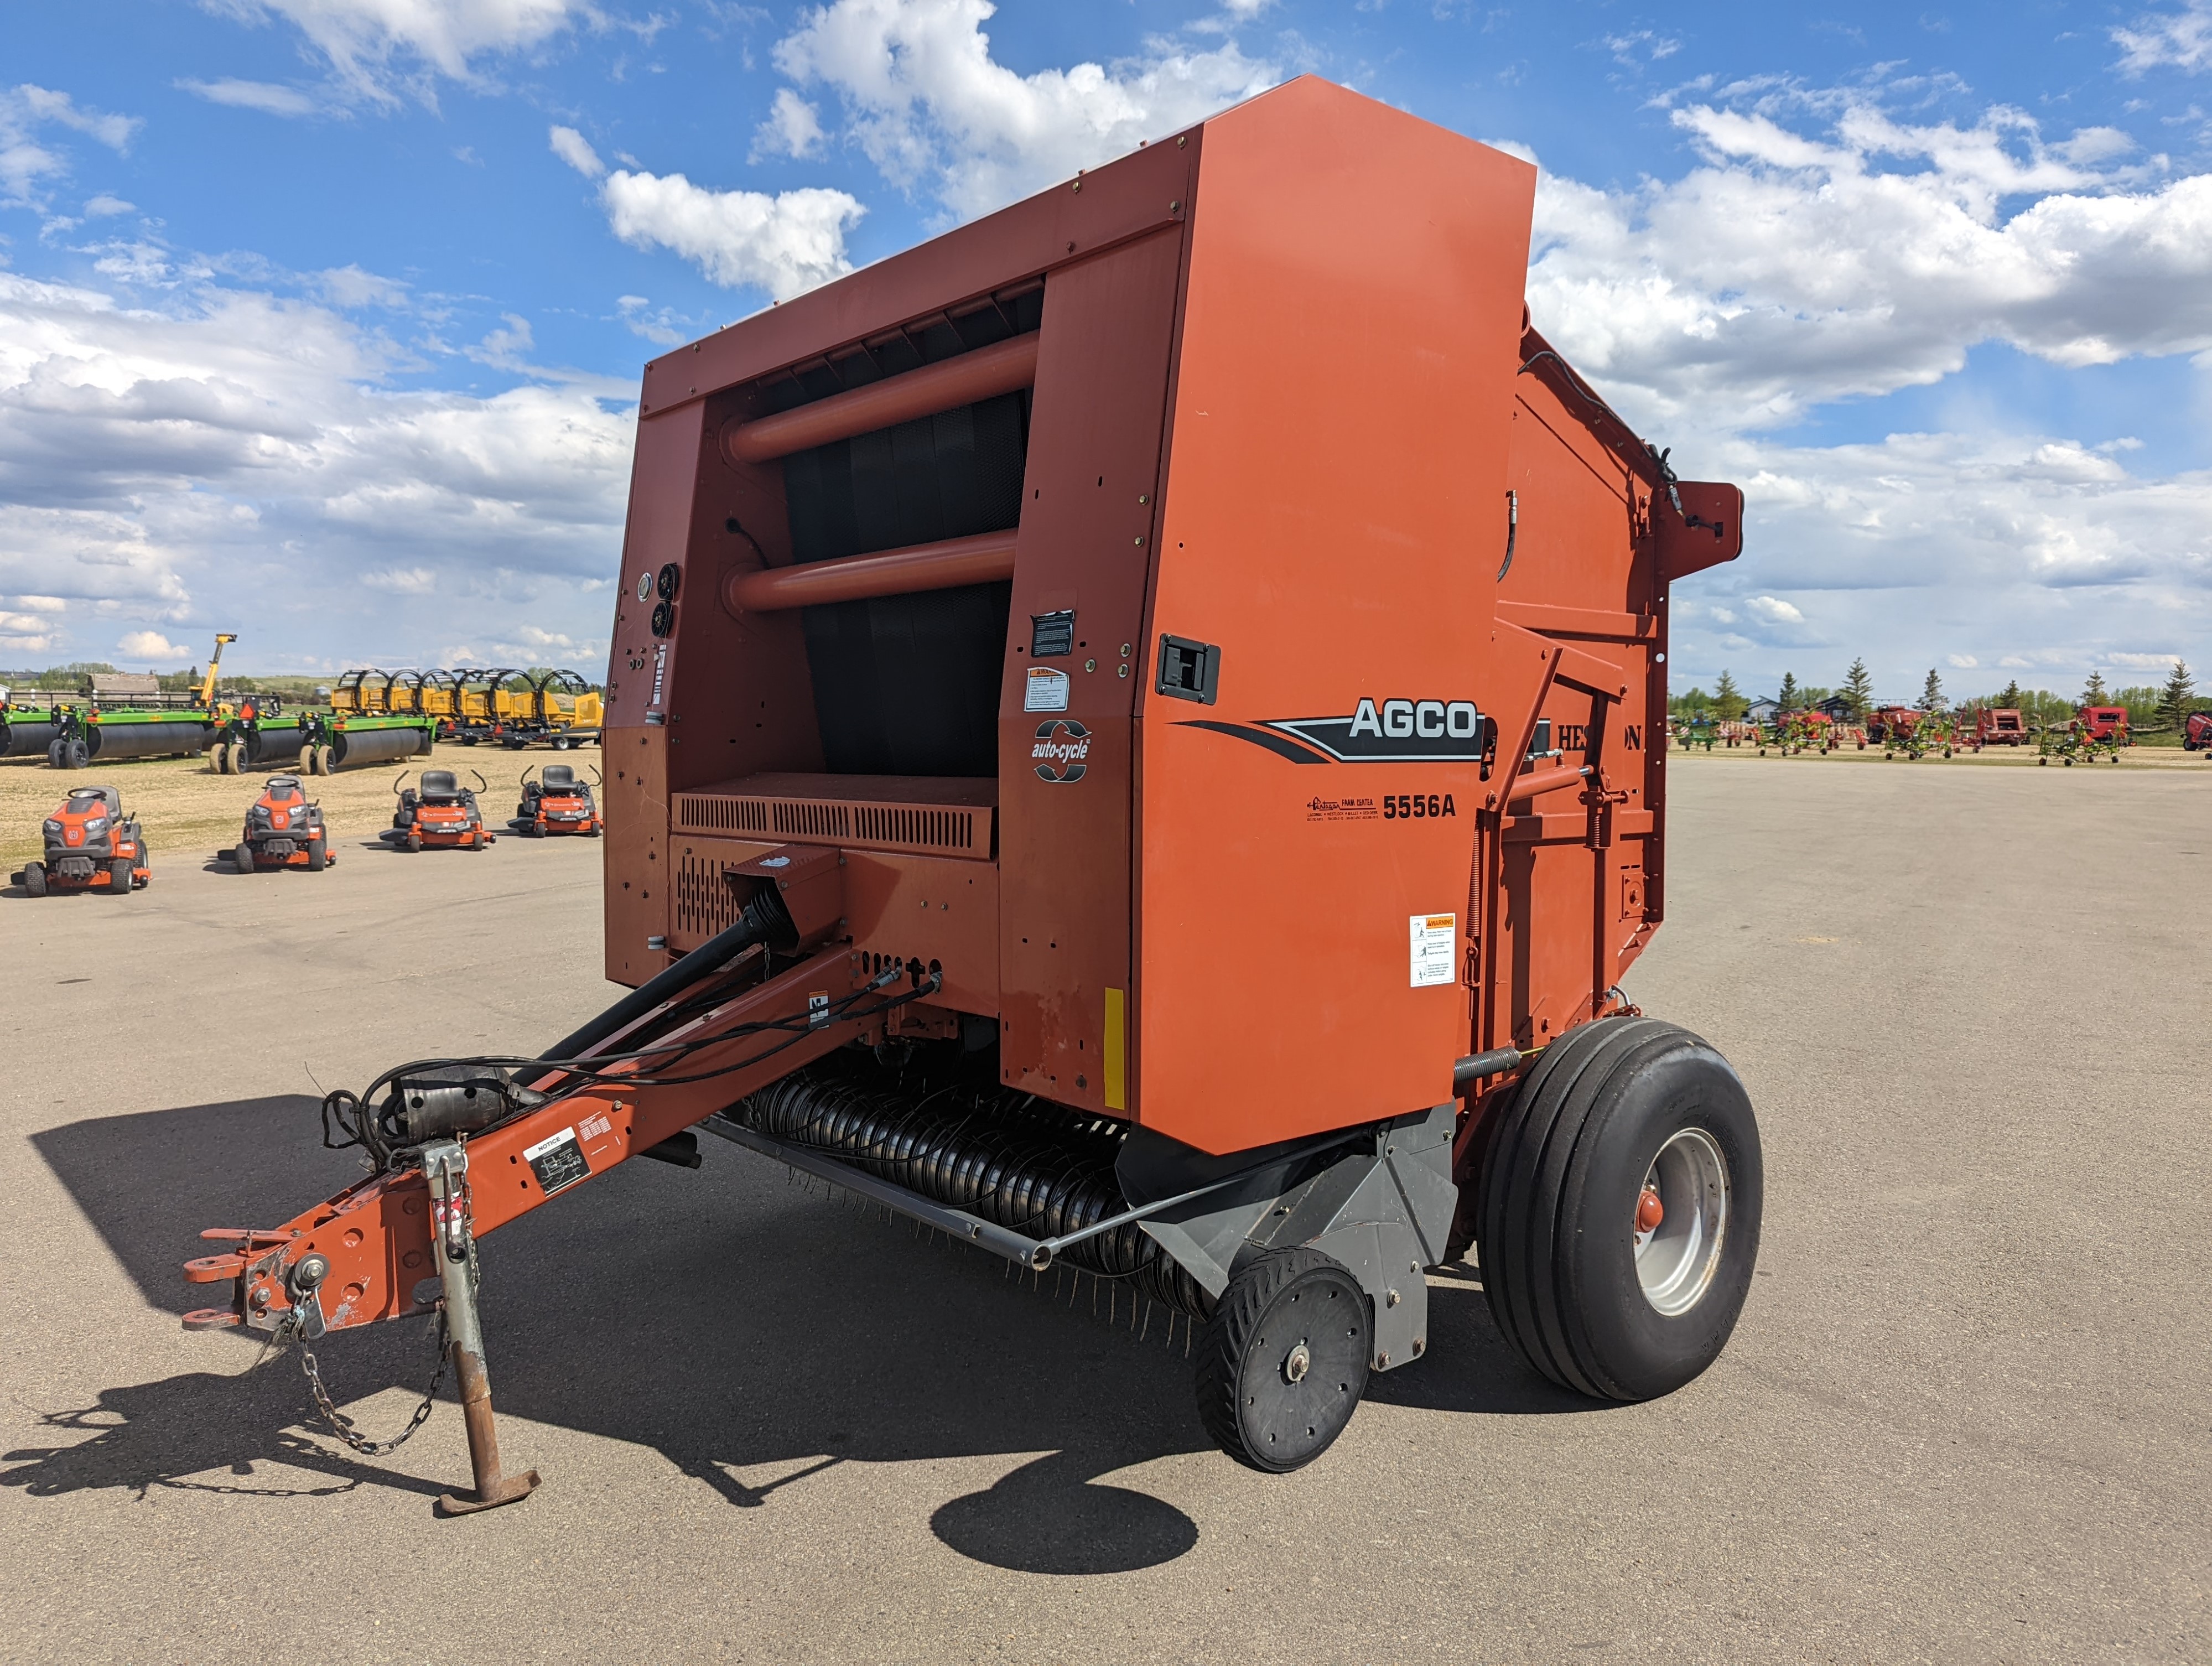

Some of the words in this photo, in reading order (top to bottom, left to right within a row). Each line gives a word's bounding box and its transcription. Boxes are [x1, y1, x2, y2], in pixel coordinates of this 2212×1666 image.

[1348, 699, 1476, 738] AGCO
[1032, 739, 1088, 764] auto-cycle
[1384, 794, 1456, 819] 5556A
[538, 1136, 561, 1151] NOTICE
